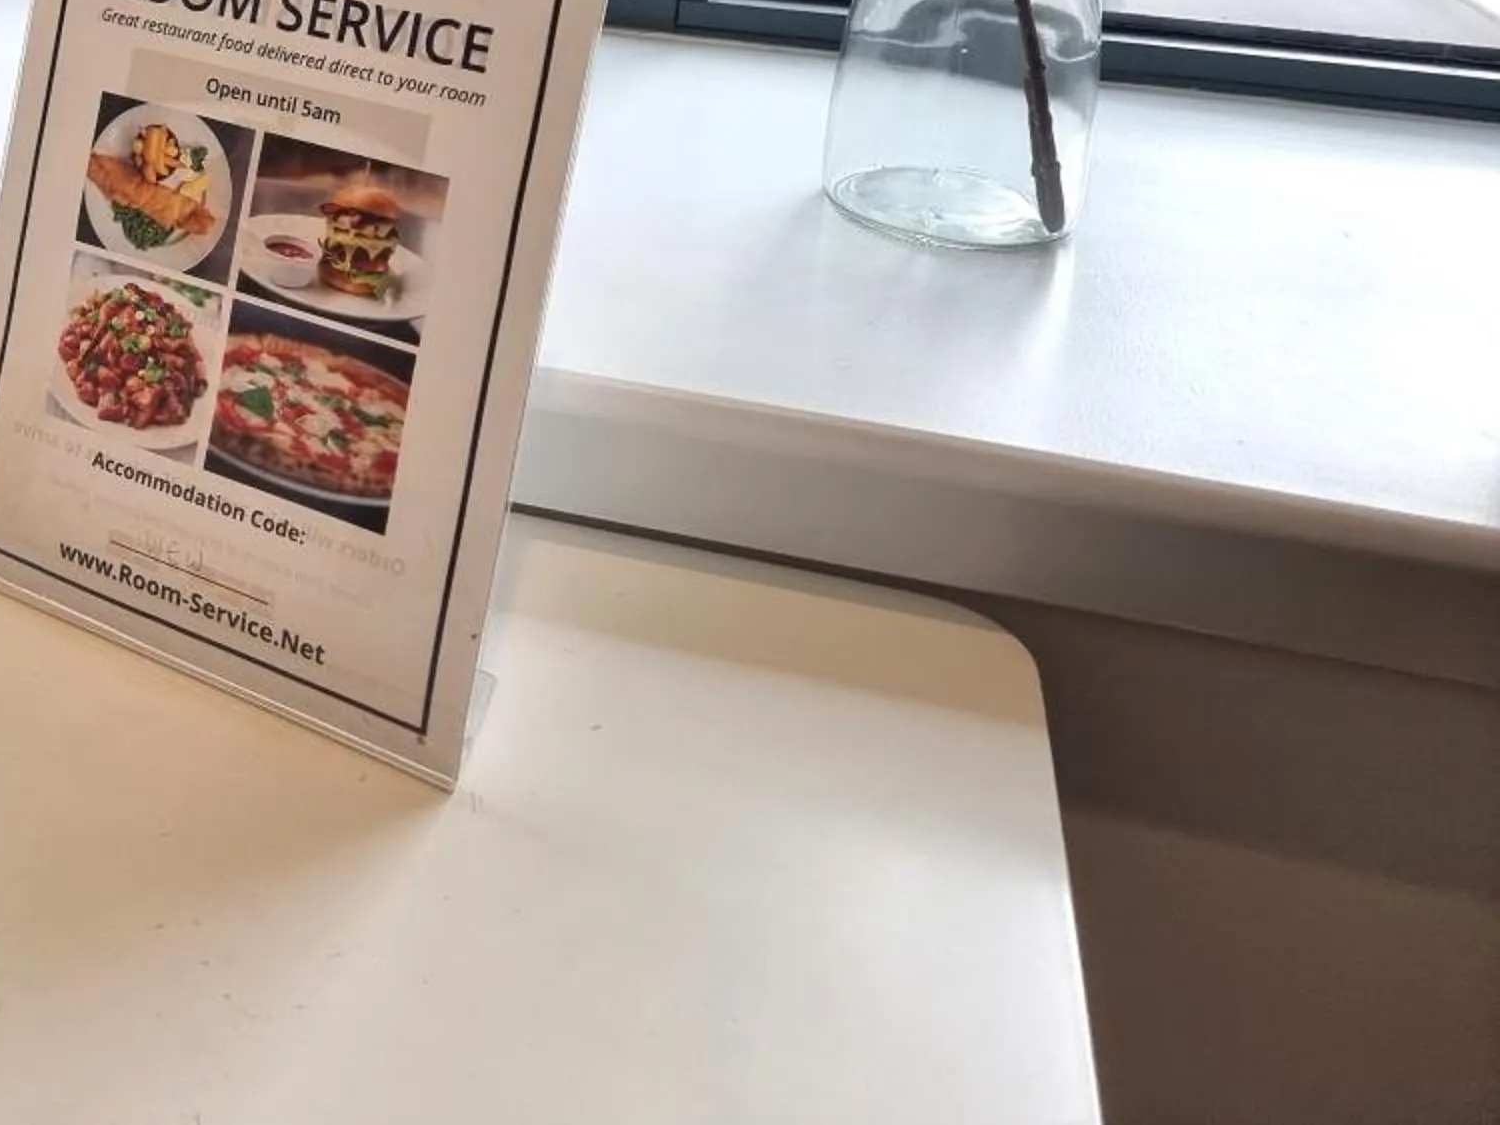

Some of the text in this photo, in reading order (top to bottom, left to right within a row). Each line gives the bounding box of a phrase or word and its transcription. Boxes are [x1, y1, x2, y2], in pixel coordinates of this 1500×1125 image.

[101, 7, 488, 107] Great restaurant food delivered direct to your room
[206, 78, 342, 125] Open until 5am
[90, 450, 245, 523] Accommodation
[250, 508, 307, 546] Code:
[58, 540, 326, 666] www.Room-Service.Net
